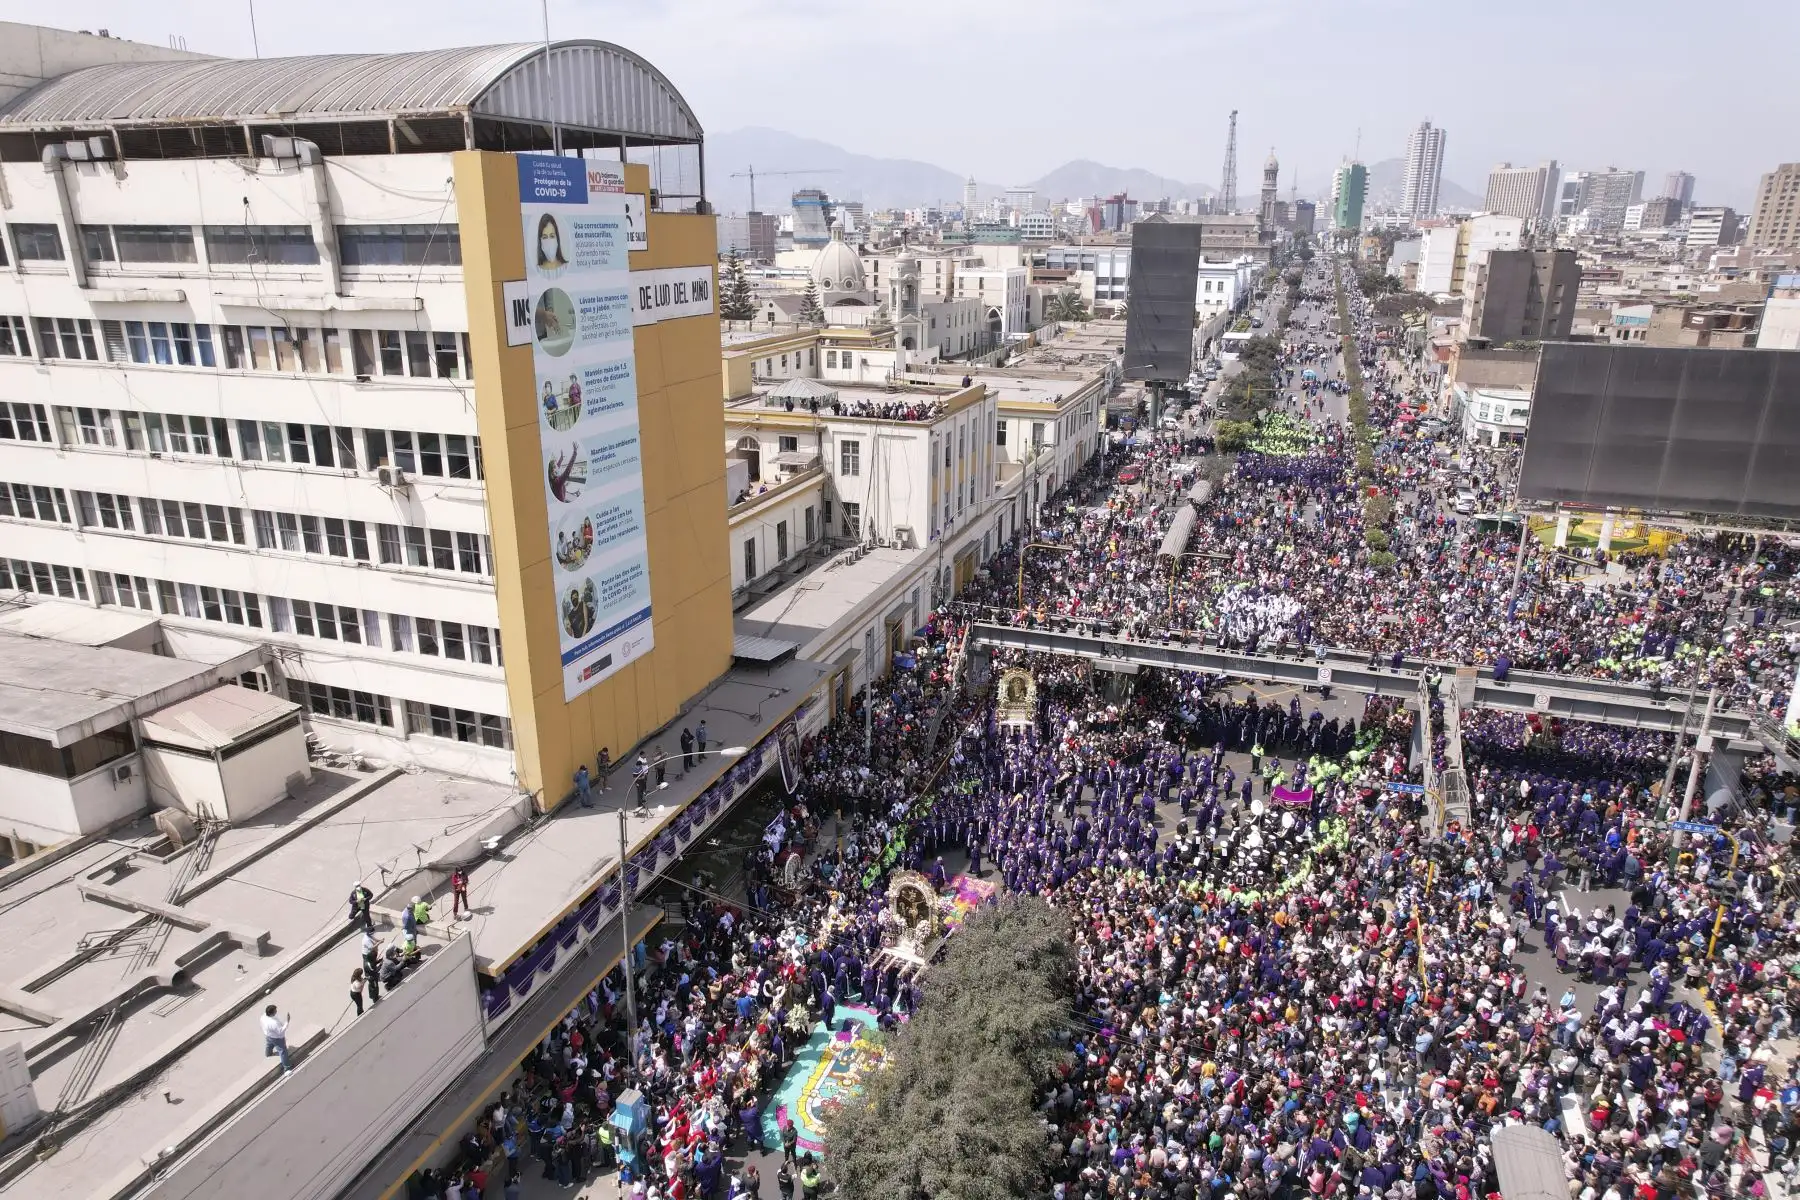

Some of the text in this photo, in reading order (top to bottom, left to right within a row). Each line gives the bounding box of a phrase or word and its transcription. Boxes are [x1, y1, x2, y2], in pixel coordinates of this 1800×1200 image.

[534, 178, 558, 186] Protégete
[588, 172, 600, 184] NO
[535, 188, 566, 197] COVID-19
[636, 232, 646, 241] SALUD
[580, 296, 595, 304] Lávate
[640, 286, 652, 310] DE
[655, 284, 670, 306] LUD
[674, 282, 688, 304] DEL
[586, 378, 602, 386] metros
[610, 372, 630, 381] distancia
[596, 510, 608, 519] Cuida
[597, 516, 617, 528] personas
[598, 537, 609, 546] Evita
